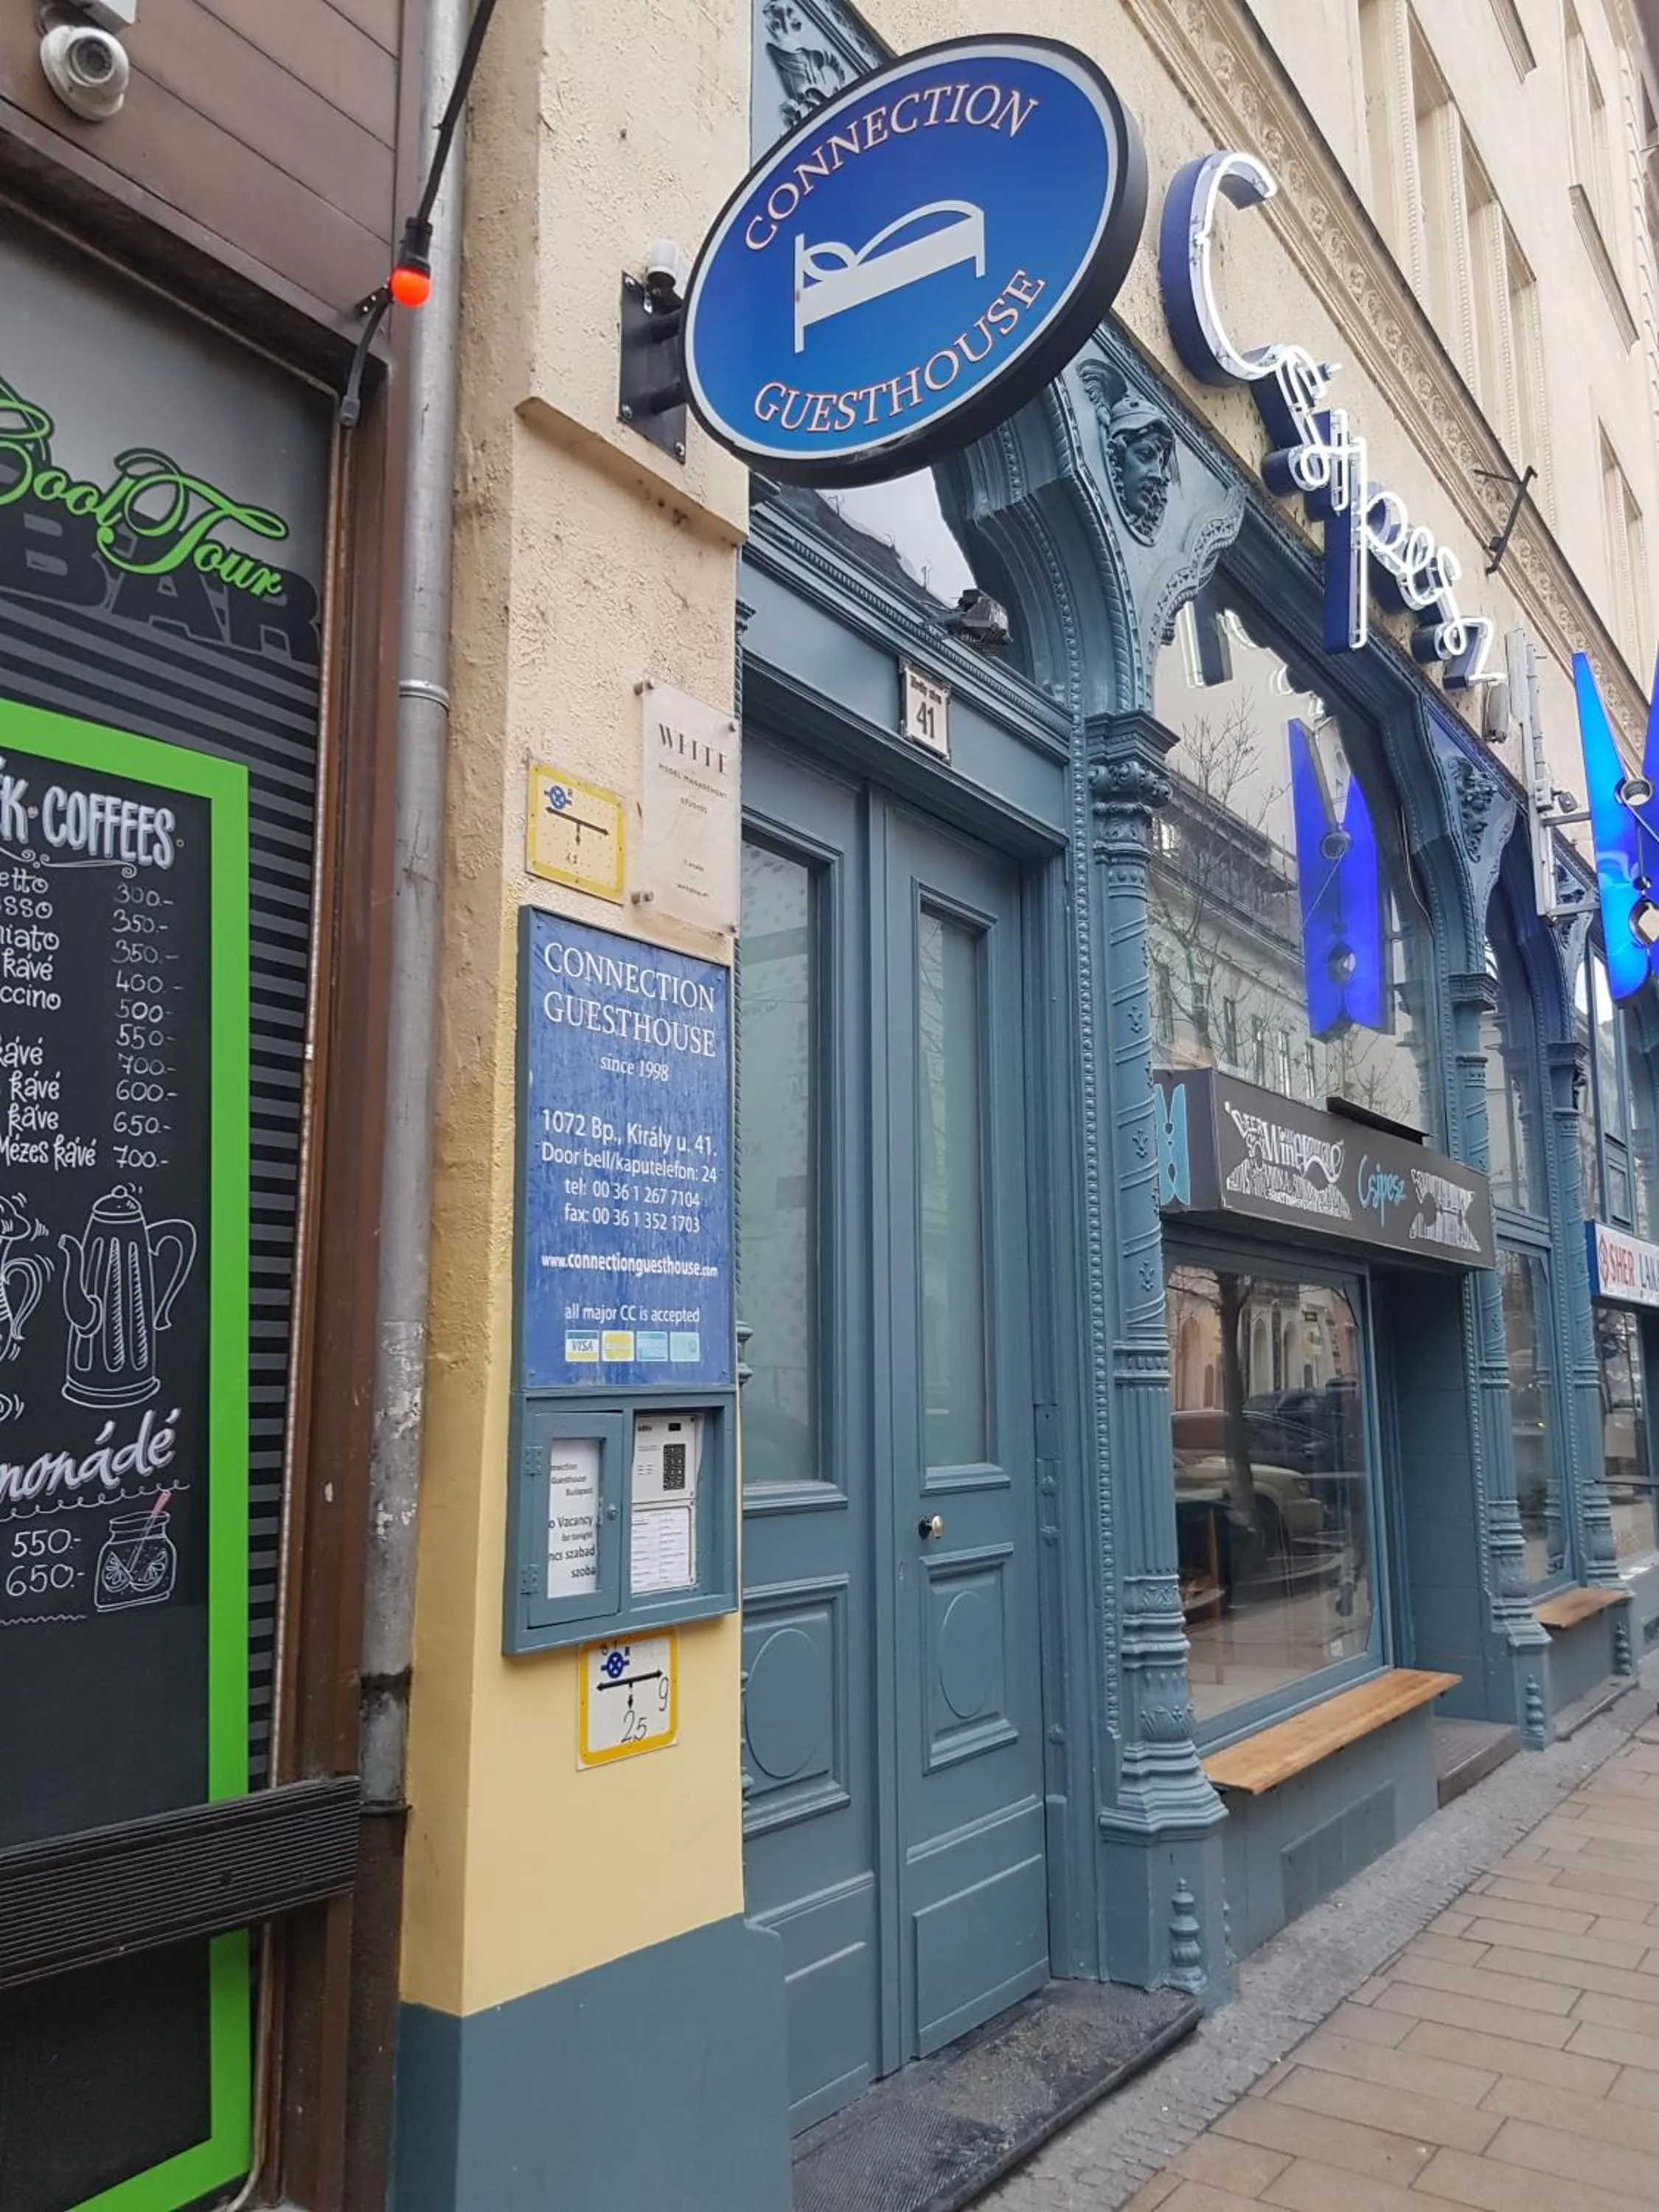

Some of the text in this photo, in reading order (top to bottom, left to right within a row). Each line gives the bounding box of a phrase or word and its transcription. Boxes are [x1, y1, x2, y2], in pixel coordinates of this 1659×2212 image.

[744, 83, 1039, 251] CONNECTION
[753, 268, 1046, 434] GUESTHOUSE
[97, 448, 289, 596] Tour
[916, 701, 935, 740] 41
[42, 786, 176, 870] COFFEES
[0, 895, 52, 919] sso
[1, 947, 53, 981] kávé
[544, 942, 714, 1012] CONNECTION
[543, 991, 716, 1057] GUESTHOUSE
[9, 1070, 60, 1102] kávé
[600, 1054, 669, 1082] since 1998
[542, 1108, 588, 1137] 1072
[627, 1122, 672, 1154] Király
[677, 1136, 691, 1152] u.
[695, 1135, 717, 1156] 41.
[53, 1133, 96, 1171] kávé
[541, 1141, 580, 1164] Door
[702, 1166, 717, 1183] 24
[566, 1178, 700, 1208] tel: 00 36 1 267 7104
[565, 1203, 700, 1234] fax: 00 36 1 352 1703
[541, 1252, 718, 1277] www.connectionguesthouse.com
[565, 1302, 700, 1324] all major CC is accepted
[572, 1340, 592, 1352] VISA
[557, 1515, 593, 1528] Vacancy
